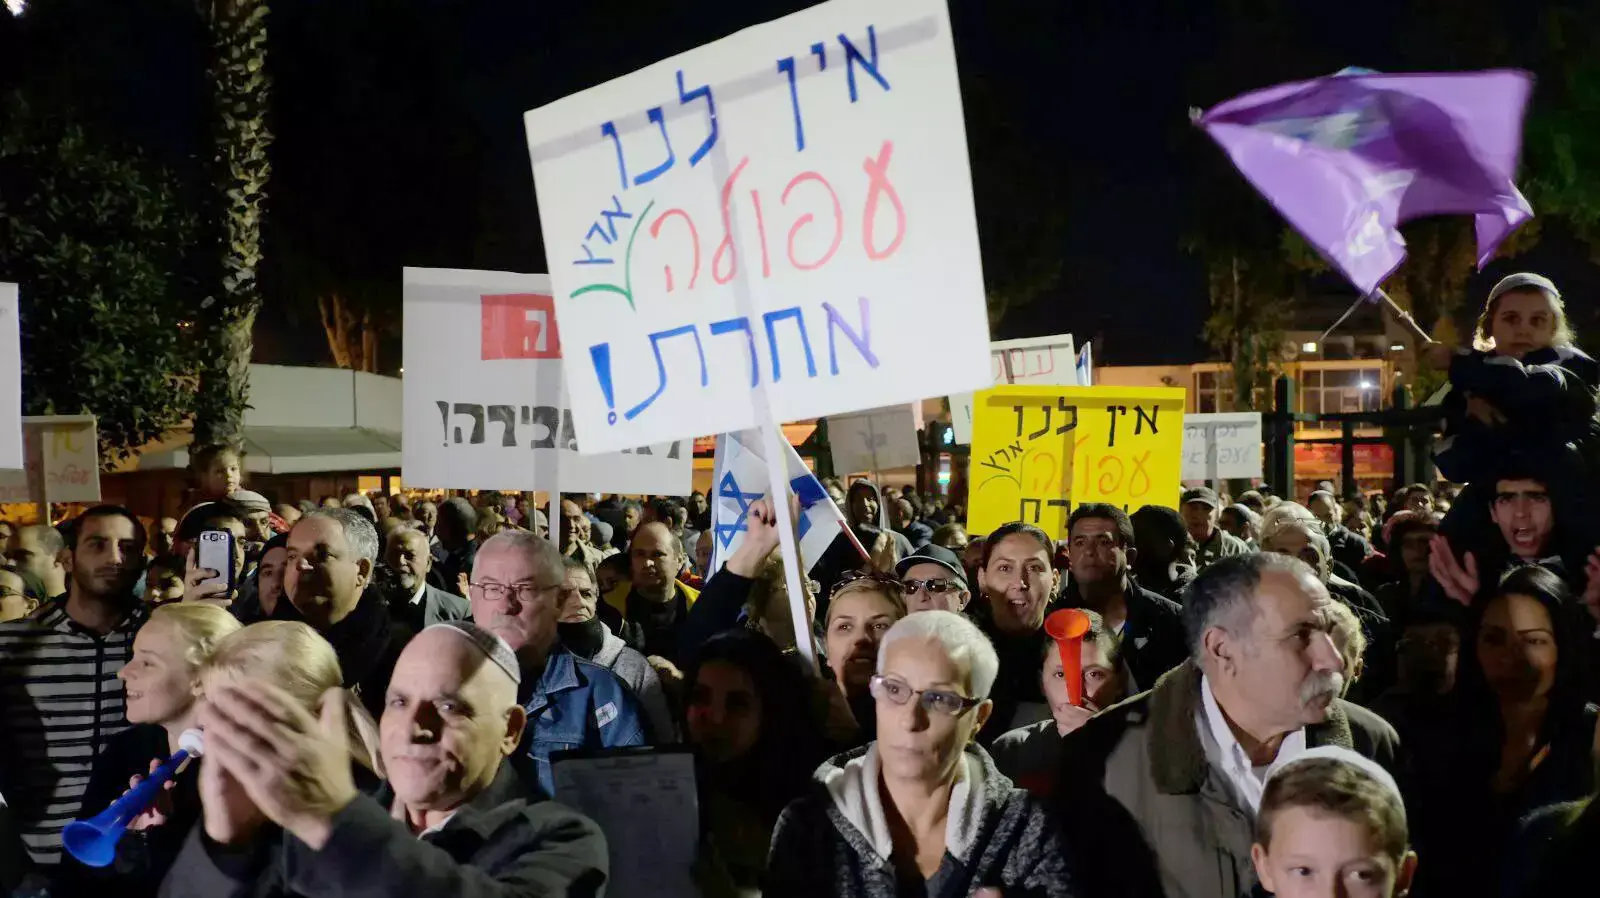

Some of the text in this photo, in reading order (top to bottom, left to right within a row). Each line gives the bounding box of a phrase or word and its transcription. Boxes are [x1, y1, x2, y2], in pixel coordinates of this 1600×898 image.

[600, 25, 891, 190] אין לנו
[572, 195, 633, 267] ארץ
[649, 139, 907, 293] עפולה
[589, 297, 880, 426] אחרת!
[1013, 396, 1078, 440] לנו
[1106, 404, 1160, 447] אין
[981, 440, 1024, 473] ארץ
